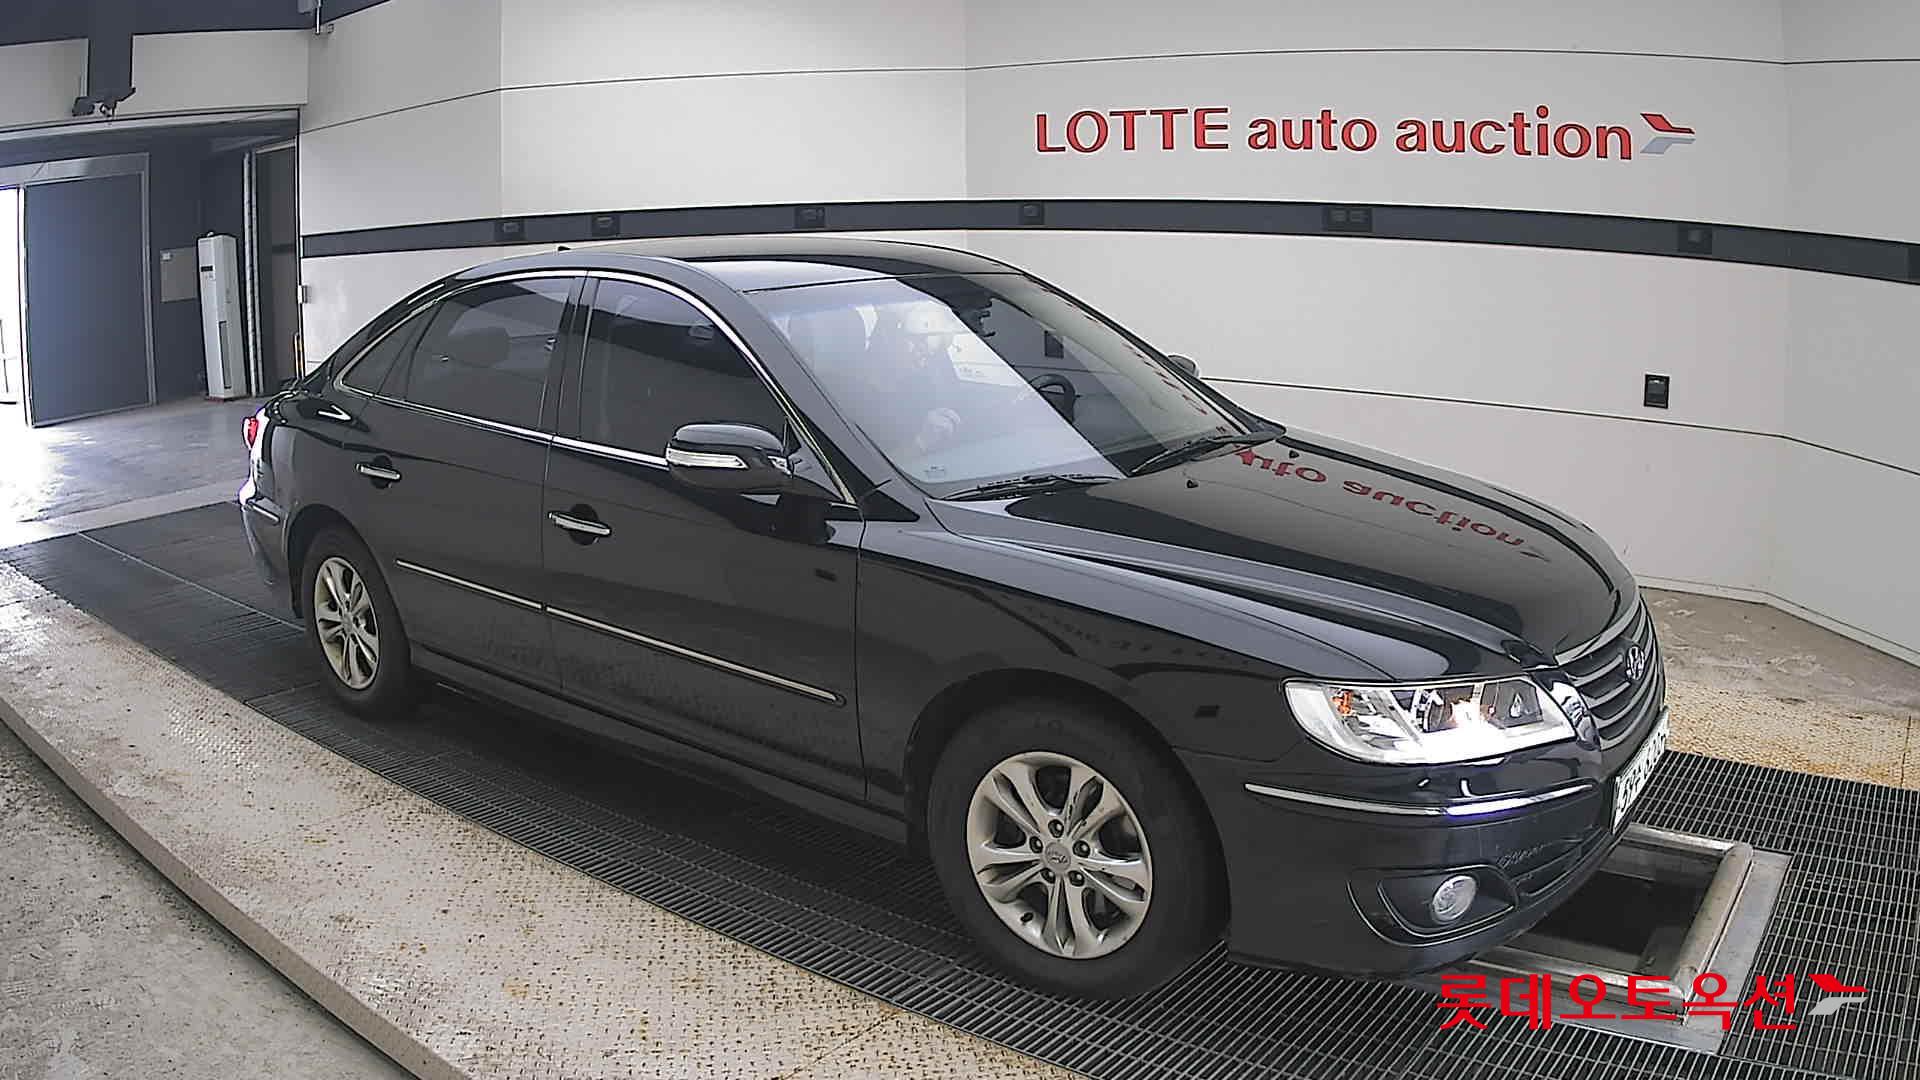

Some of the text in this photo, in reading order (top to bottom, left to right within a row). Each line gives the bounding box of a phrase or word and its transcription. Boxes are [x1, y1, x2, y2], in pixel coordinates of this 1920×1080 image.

[1036, 105, 1632, 160] LOTTE auto auction
